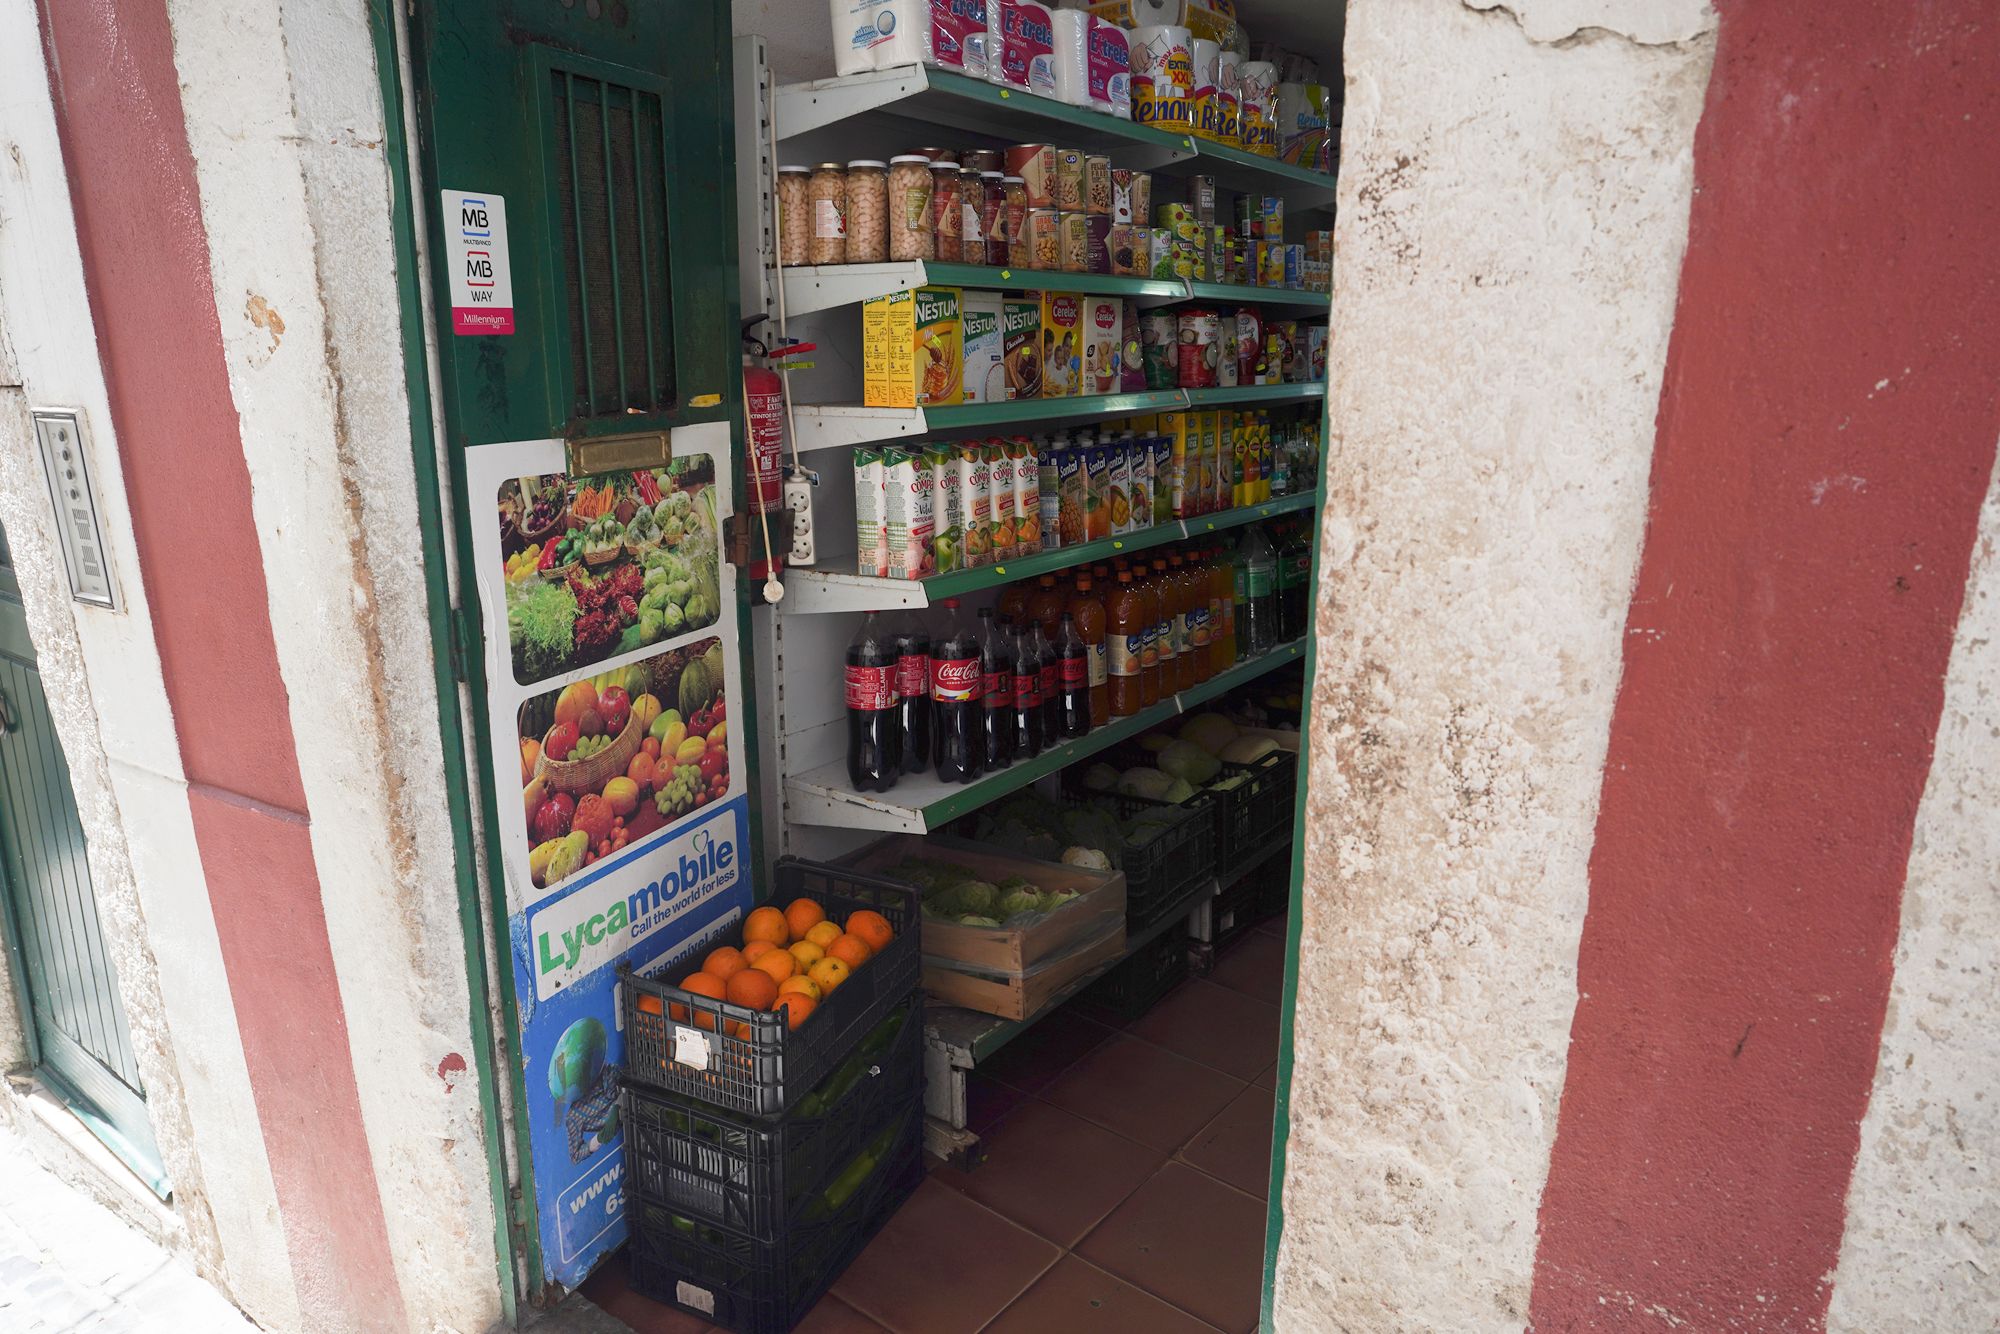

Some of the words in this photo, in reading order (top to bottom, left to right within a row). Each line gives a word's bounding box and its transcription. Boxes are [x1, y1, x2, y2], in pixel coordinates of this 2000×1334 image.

[1172, 70, 1191, 85] XXL
[462, 208, 489, 228] MB
[467, 260, 493, 278] MB
[471, 290, 493, 302] WAY
[463, 312, 505, 324] Millennium
[914, 299, 959, 324] NESTUM
[1003, 309, 1040, 332] NESTUM
[1053, 305, 1077, 318] Cerelac
[1096, 311, 1114, 322] Cerelac
[963, 317, 998, 336] NESTUM
[1088, 456, 1106, 474] Santal
[1109, 453, 1124, 469] antal
[1155, 448, 1170, 465] Santal
[1060, 460, 1078, 479] Santal
[538, 838, 733, 976] Lycamobile
[631, 917, 651, 938] Call
[653, 909, 671, 926] the
[672, 890, 700, 913] world
[701, 881, 716, 896] for
[717, 869, 735, 888] less
[643, 935, 710, 979] Disponível
